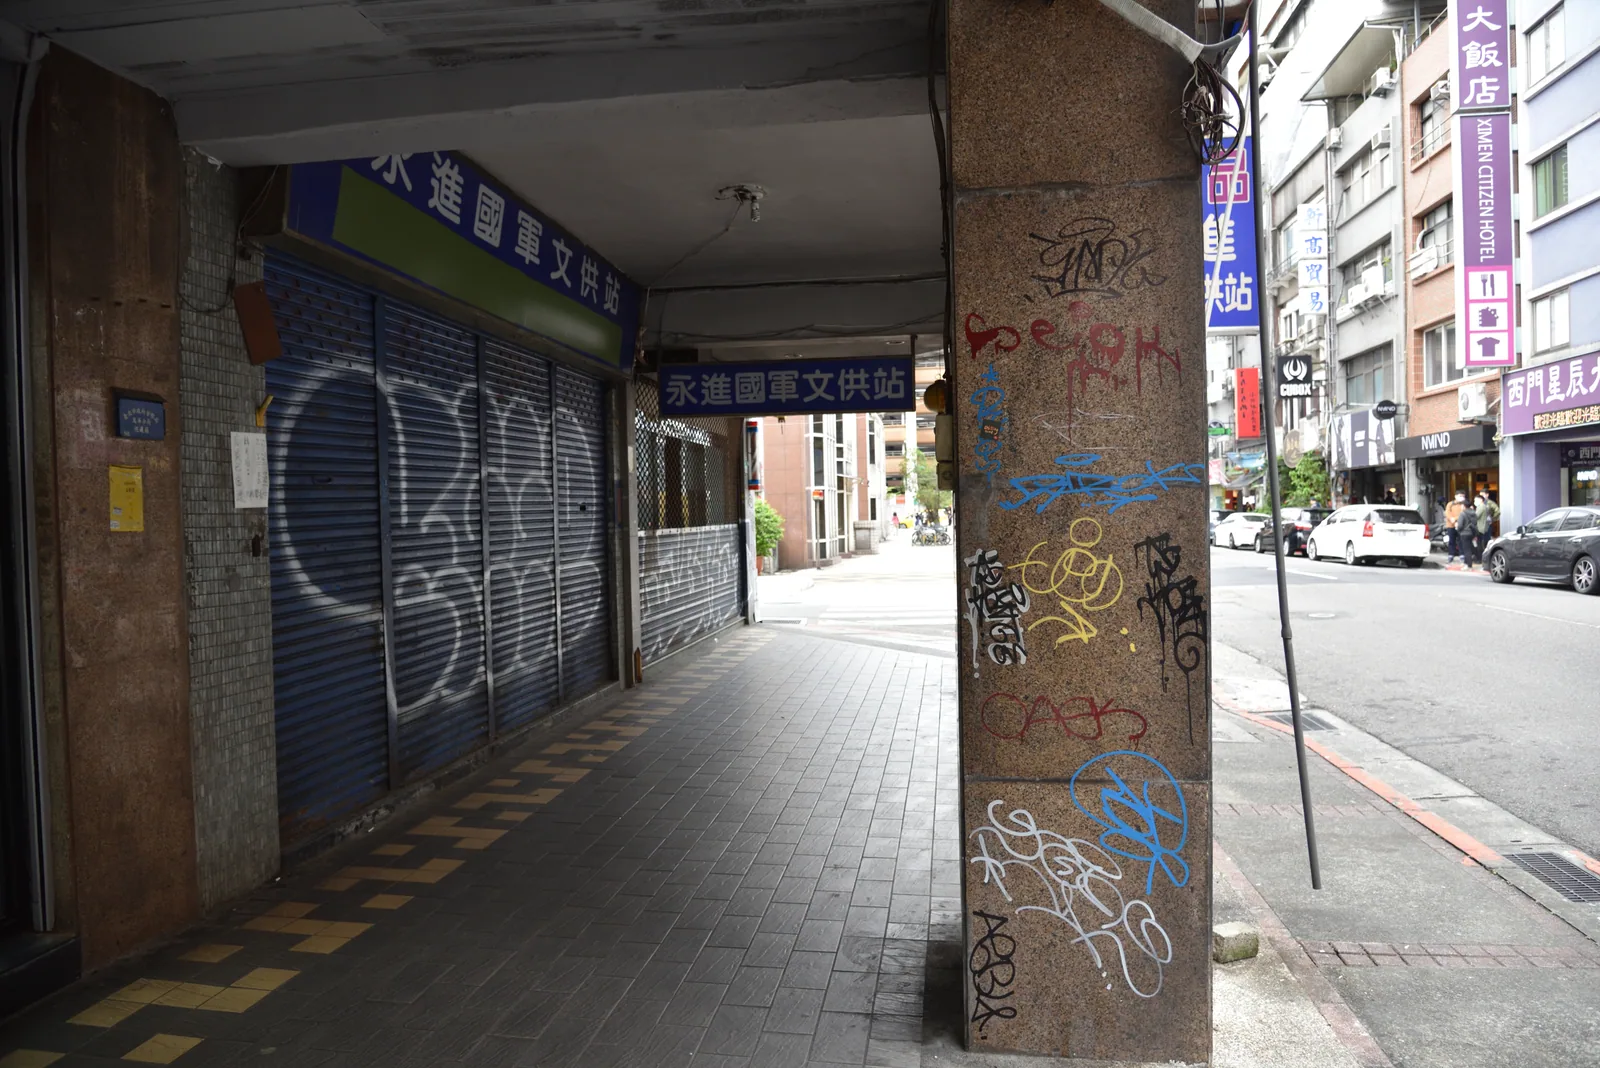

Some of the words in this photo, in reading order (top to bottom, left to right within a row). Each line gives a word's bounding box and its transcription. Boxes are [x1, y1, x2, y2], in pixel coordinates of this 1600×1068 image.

[1463, 5, 1502, 105] 大飯店
[1477, 118, 1493, 162] XIMEN
[1478, 165, 1494, 217] CITIZEN
[371, 152, 619, 315] 永進國軍文供站
[1480, 220, 1495, 263] HOTEL
[666, 366, 906, 407] 永進國軍文供站
[1280, 384, 1311, 397] CUBOX
